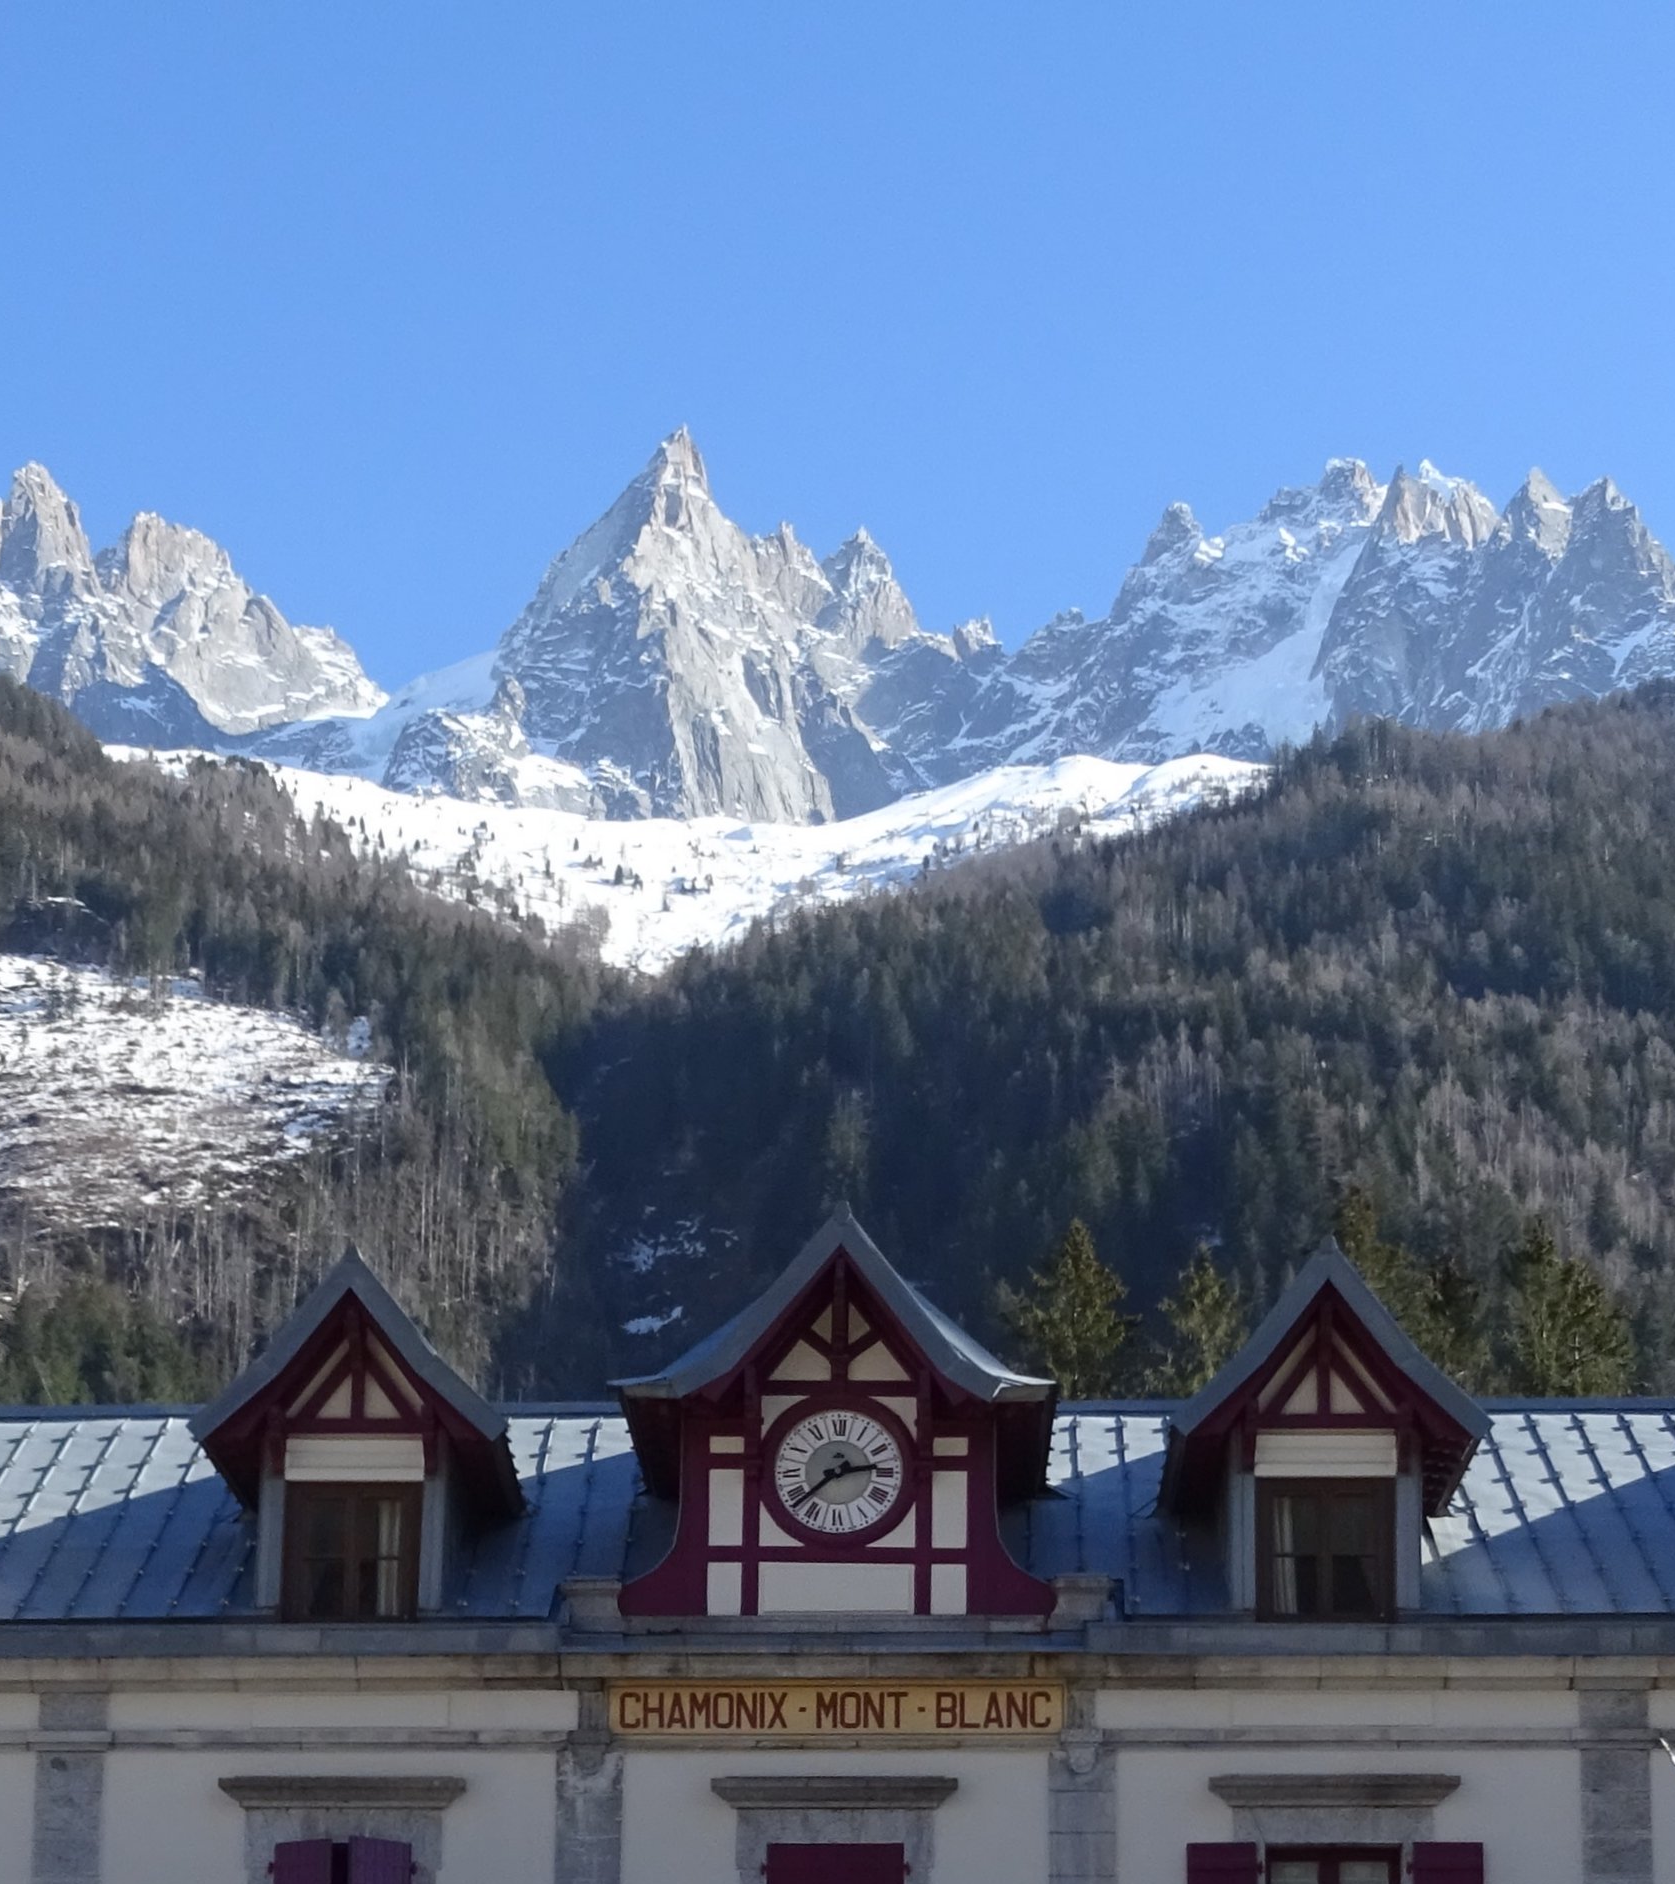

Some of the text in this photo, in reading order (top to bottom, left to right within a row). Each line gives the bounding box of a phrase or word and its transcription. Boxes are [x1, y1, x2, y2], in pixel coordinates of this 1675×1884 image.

[619, 1690, 788, 1729] CHAMONIX
[815, 1690, 909, 1729] MONT
[935, 1690, 1053, 1729] BLANC
